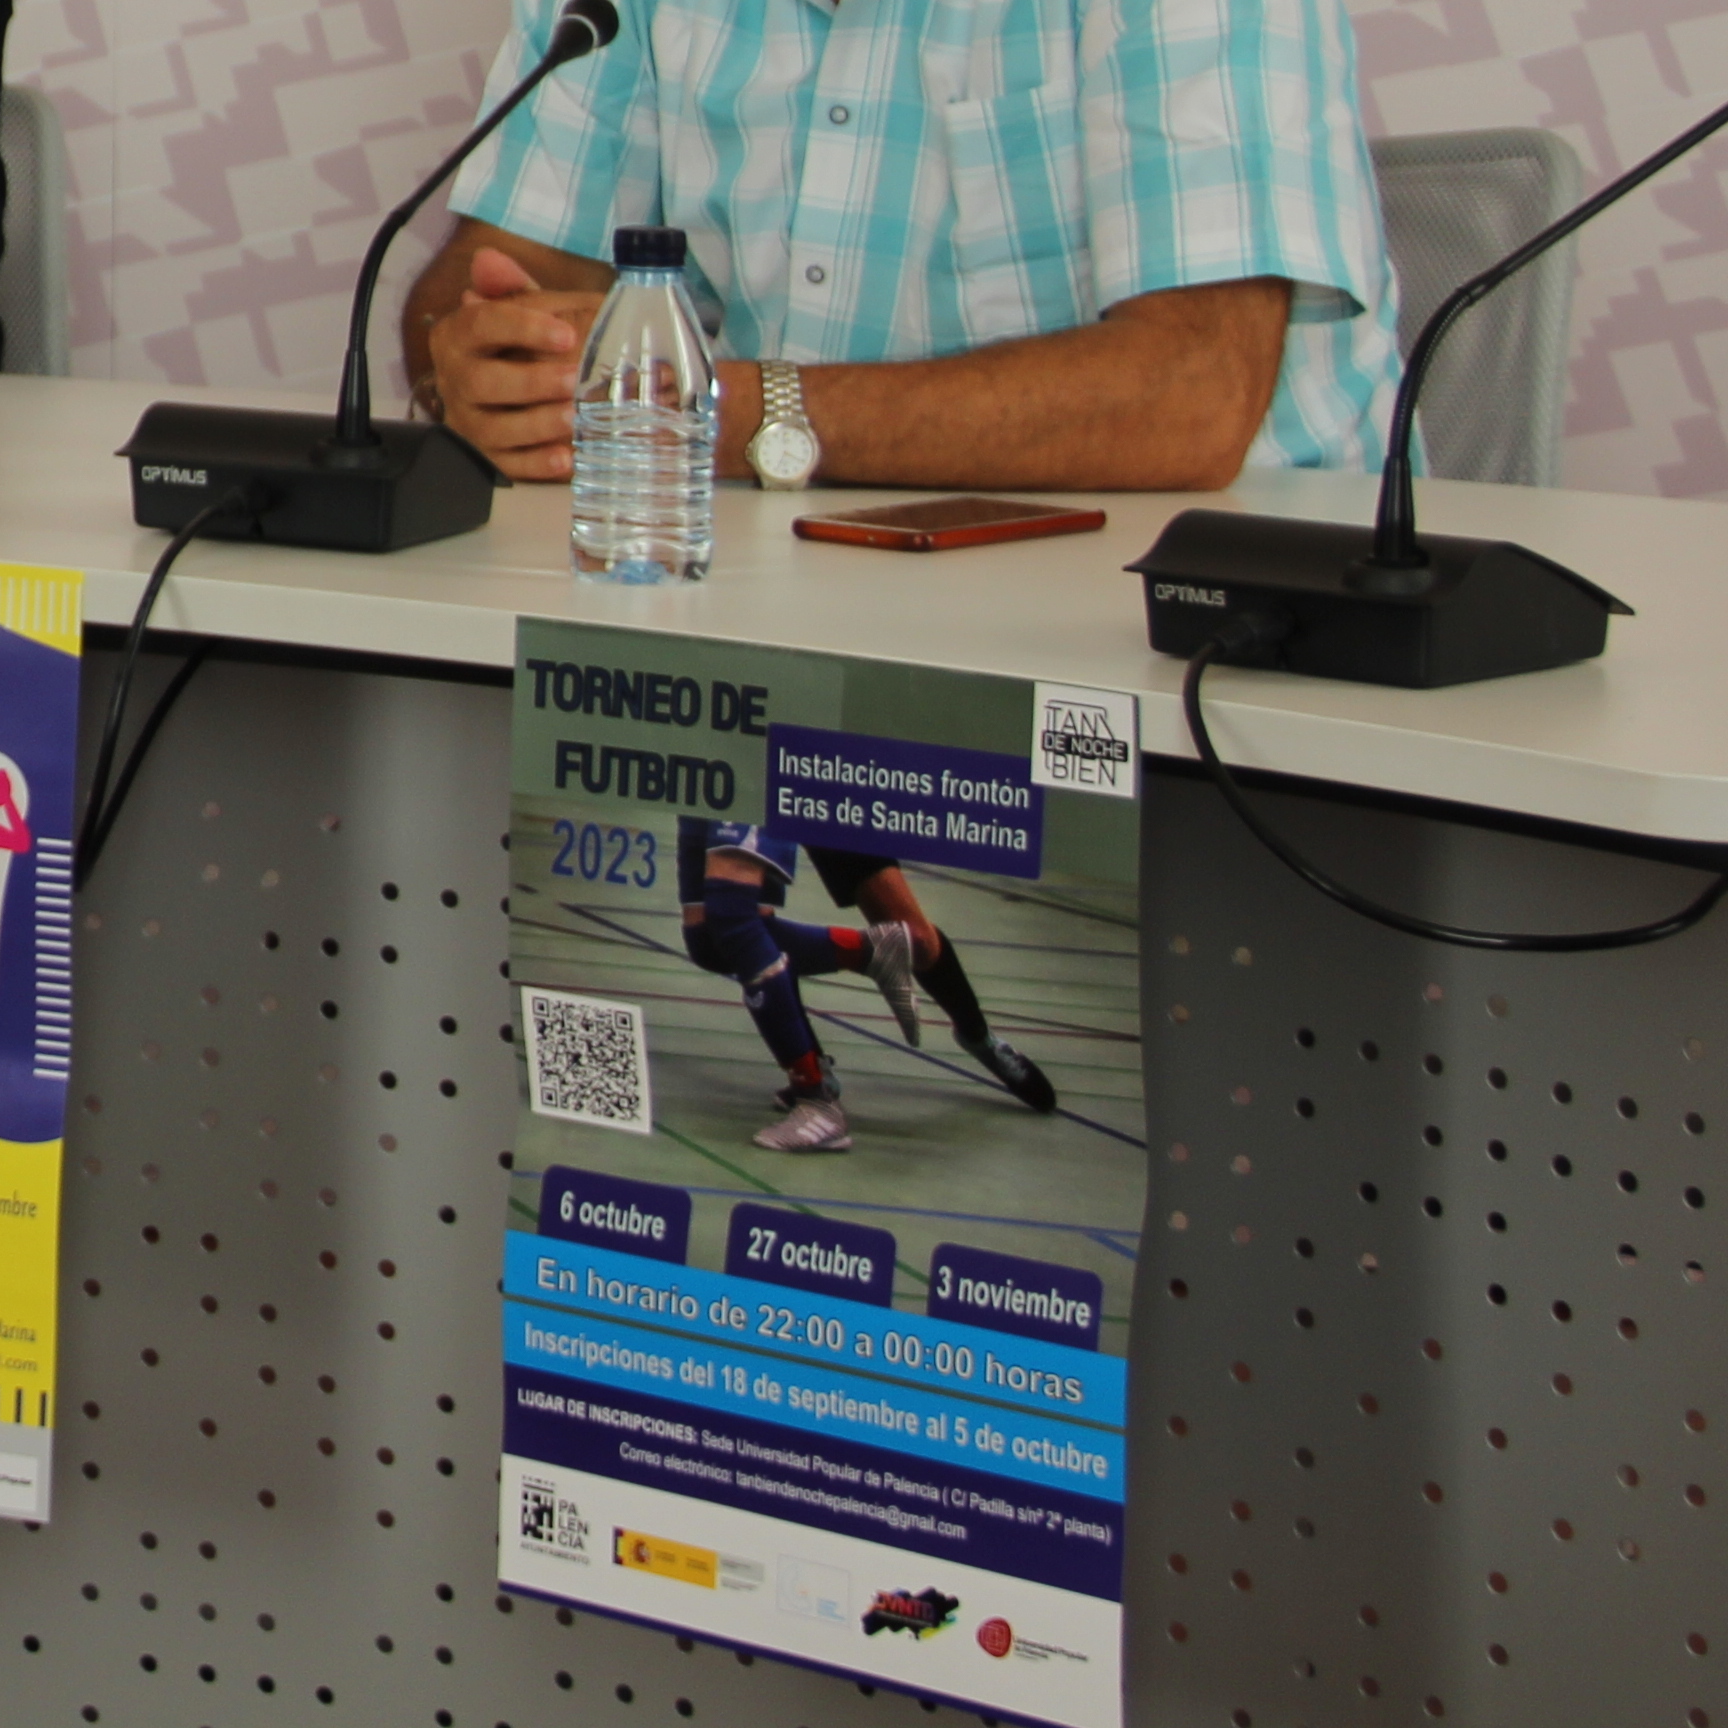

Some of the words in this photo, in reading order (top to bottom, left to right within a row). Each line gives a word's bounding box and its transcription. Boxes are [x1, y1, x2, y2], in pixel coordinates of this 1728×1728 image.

[141, 463, 207, 486] OPTIMUS
[1154, 583, 1226, 606] OPTIMUS
[525, 657, 702, 728] TORNEO
[710, 679, 769, 737] DE
[1044, 704, 1097, 735] TAN
[554, 739, 736, 811] FUTBITO
[1043, 731, 1066, 753] DE
[1070, 735, 1125, 761] NOCHE
[1051, 752, 1117, 788] BIEN
[778, 746, 935, 797] Instalaciones
[941, 769, 1030, 810] frontón
[777, 786, 830, 823] Eras
[835, 796, 864, 827] de
[870, 800, 939, 839] Santa
[945, 811, 1029, 852] Marina
[550, 818, 657, 889] 2023
[559, 1190, 575, 1222] 6
[578, 1200, 667, 1241] octubre
[746, 1226, 777, 1262] 27
[780, 1238, 874, 1284] octubre
[936, 1265, 953, 1300] 3
[957, 1275, 1092, 1329] noviembre
[536, 1256, 578, 1294] En
[586, 1267, 700, 1319] horario
[707, 1296, 748, 1330] de
[756, 1304, 845, 1350] 22:00
[854, 1330, 874, 1358] a
[882, 1330, 975, 1379] 00:00
[985, 1352, 1084, 1403] horas
[524, 1320, 674, 1380] Inscripciones
[679, 1356, 715, 1388] del
[720, 1366, 748, 1397] 18
[752, 1373, 783, 1404] de
[788, 1385, 920, 1435] septiembre
[925, 1412, 948, 1442] al
[953, 1416, 970, 1447] 5
[974, 1423, 1006, 1455] de
[1011, 1434, 1109, 1478] octubre
[517, 1387, 565, 1416] LUGAR
[566, 1397, 587, 1418] DE
[588, 1402, 699, 1445] INSCRIPCIONES:
[700, 1429, 735, 1454] Sede
[735, 1437, 811, 1472] Universidad
[812, 1455, 862, 1484] Popular
[863, 1467, 881, 1489] de
[883, 1472, 940, 1502] Palencia
[969, 1491, 1014, 1520] Padilla
[557, 1498, 580, 1517] PA
[619, 1441, 662, 1467] Correo
[735, 1470, 968, 1541] tanbiendenochepalencia@gmail.com
[556, 1533, 586, 1551] CIA
[557, 1515, 589, 1536] LEN
